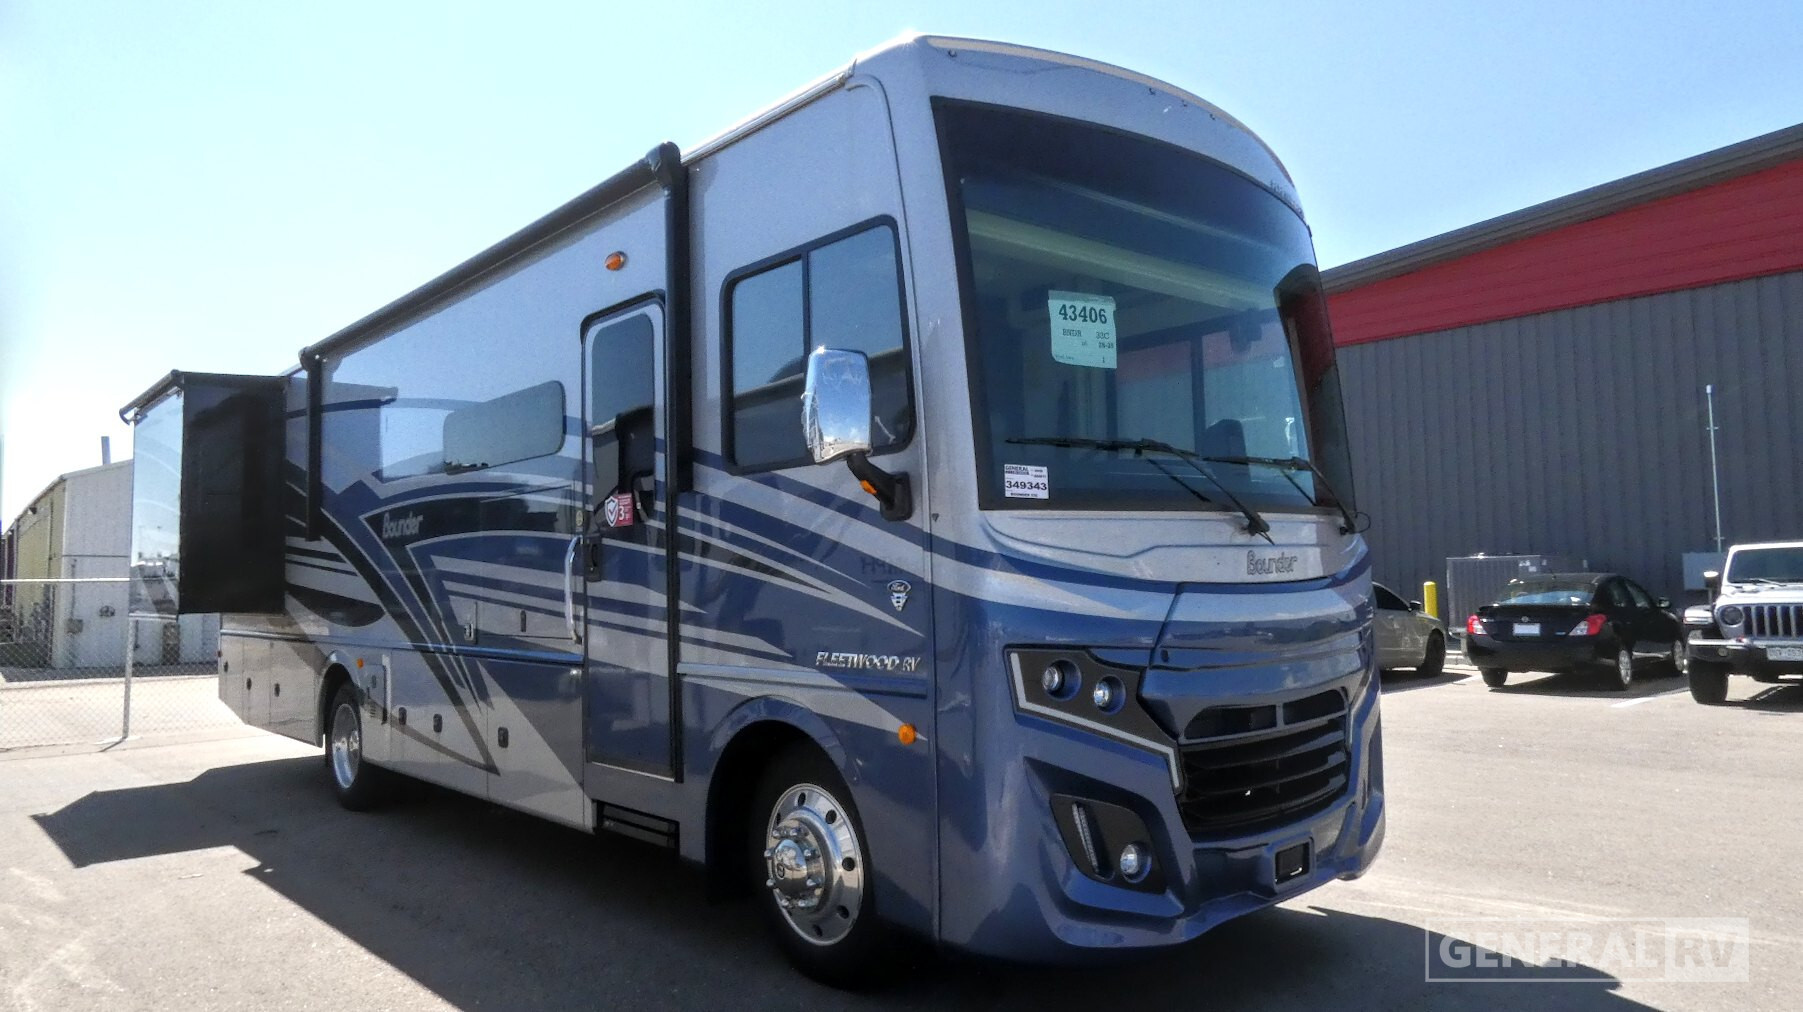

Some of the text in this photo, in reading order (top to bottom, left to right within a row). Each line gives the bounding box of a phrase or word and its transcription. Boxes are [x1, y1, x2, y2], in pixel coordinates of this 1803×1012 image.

[1058, 303, 1108, 325] 43406
[1006, 480, 1047, 490] 349343
[382, 510, 424, 539] Bounder
[1246, 549, 1298, 576] Bounder
[815, 651, 921, 672] FLEETWOOD RV
